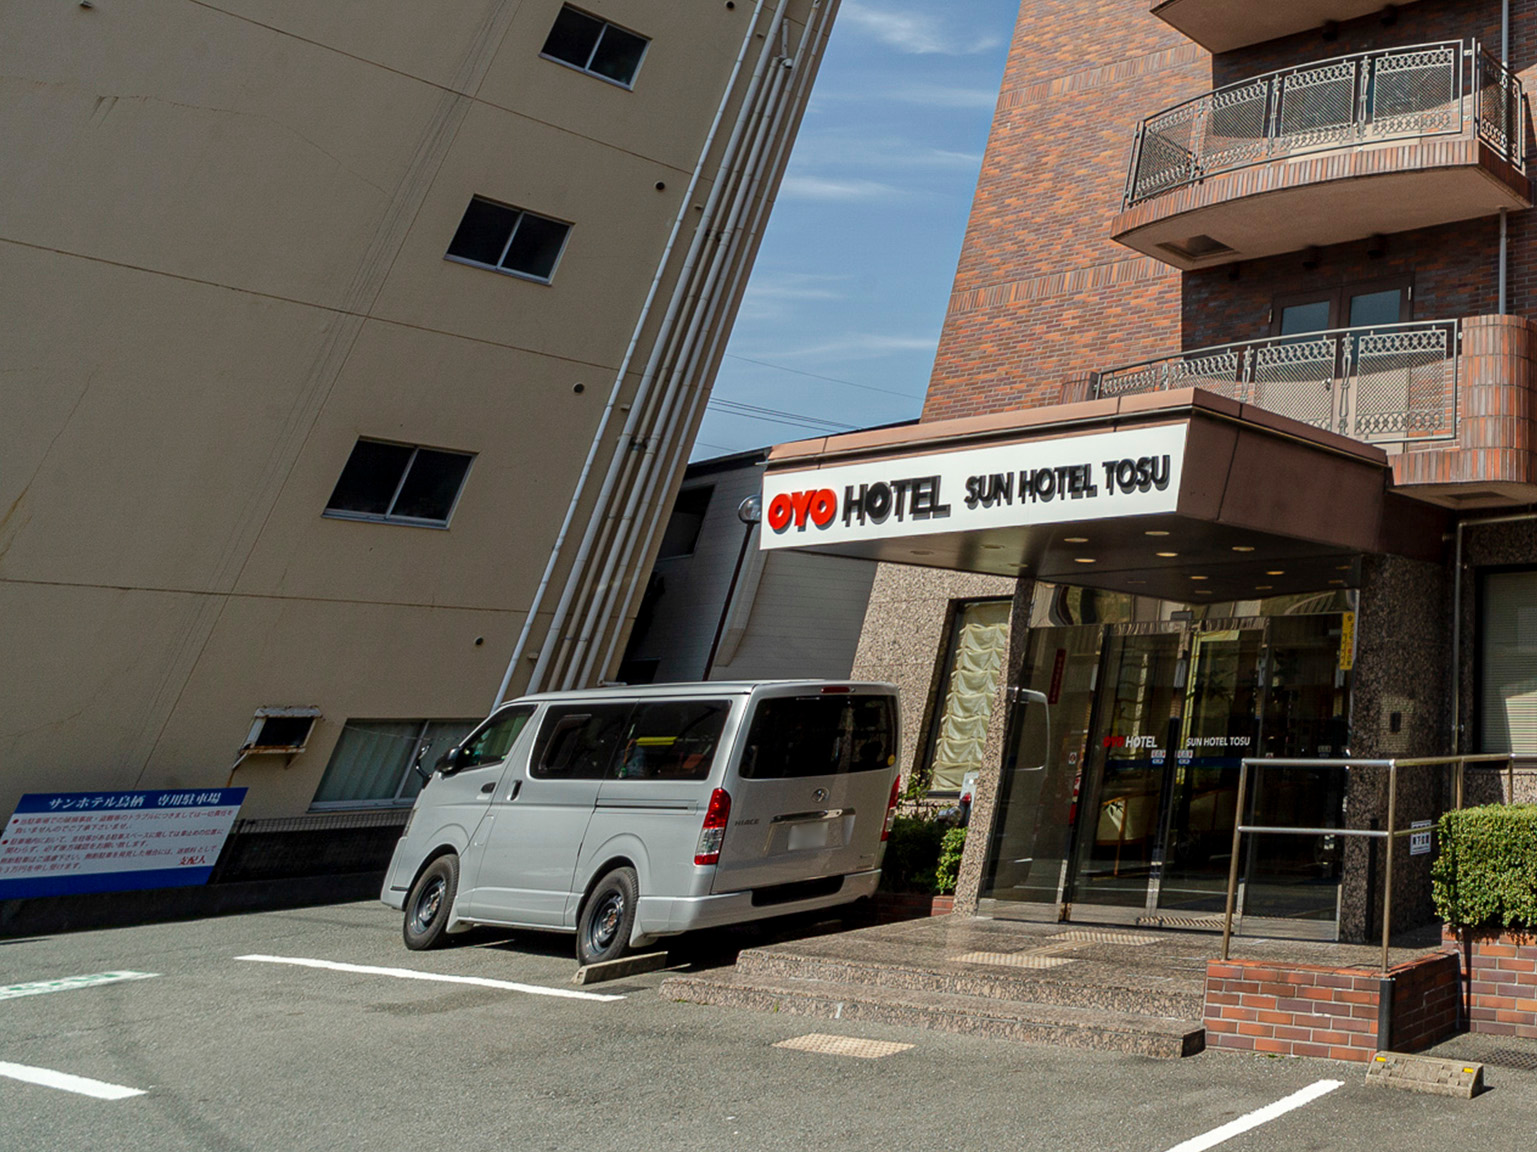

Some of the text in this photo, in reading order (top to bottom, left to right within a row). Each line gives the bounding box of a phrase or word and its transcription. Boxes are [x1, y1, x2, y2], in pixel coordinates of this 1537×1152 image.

[768, 454, 1170, 532] OYO HOTEL SUN HOTEL TOSU
[1103, 735, 1251, 748] OYO HOTEL SUN HOTEL TOSU
[49, 792, 222, 810] サンホテル鳥栖 専用駐車場
